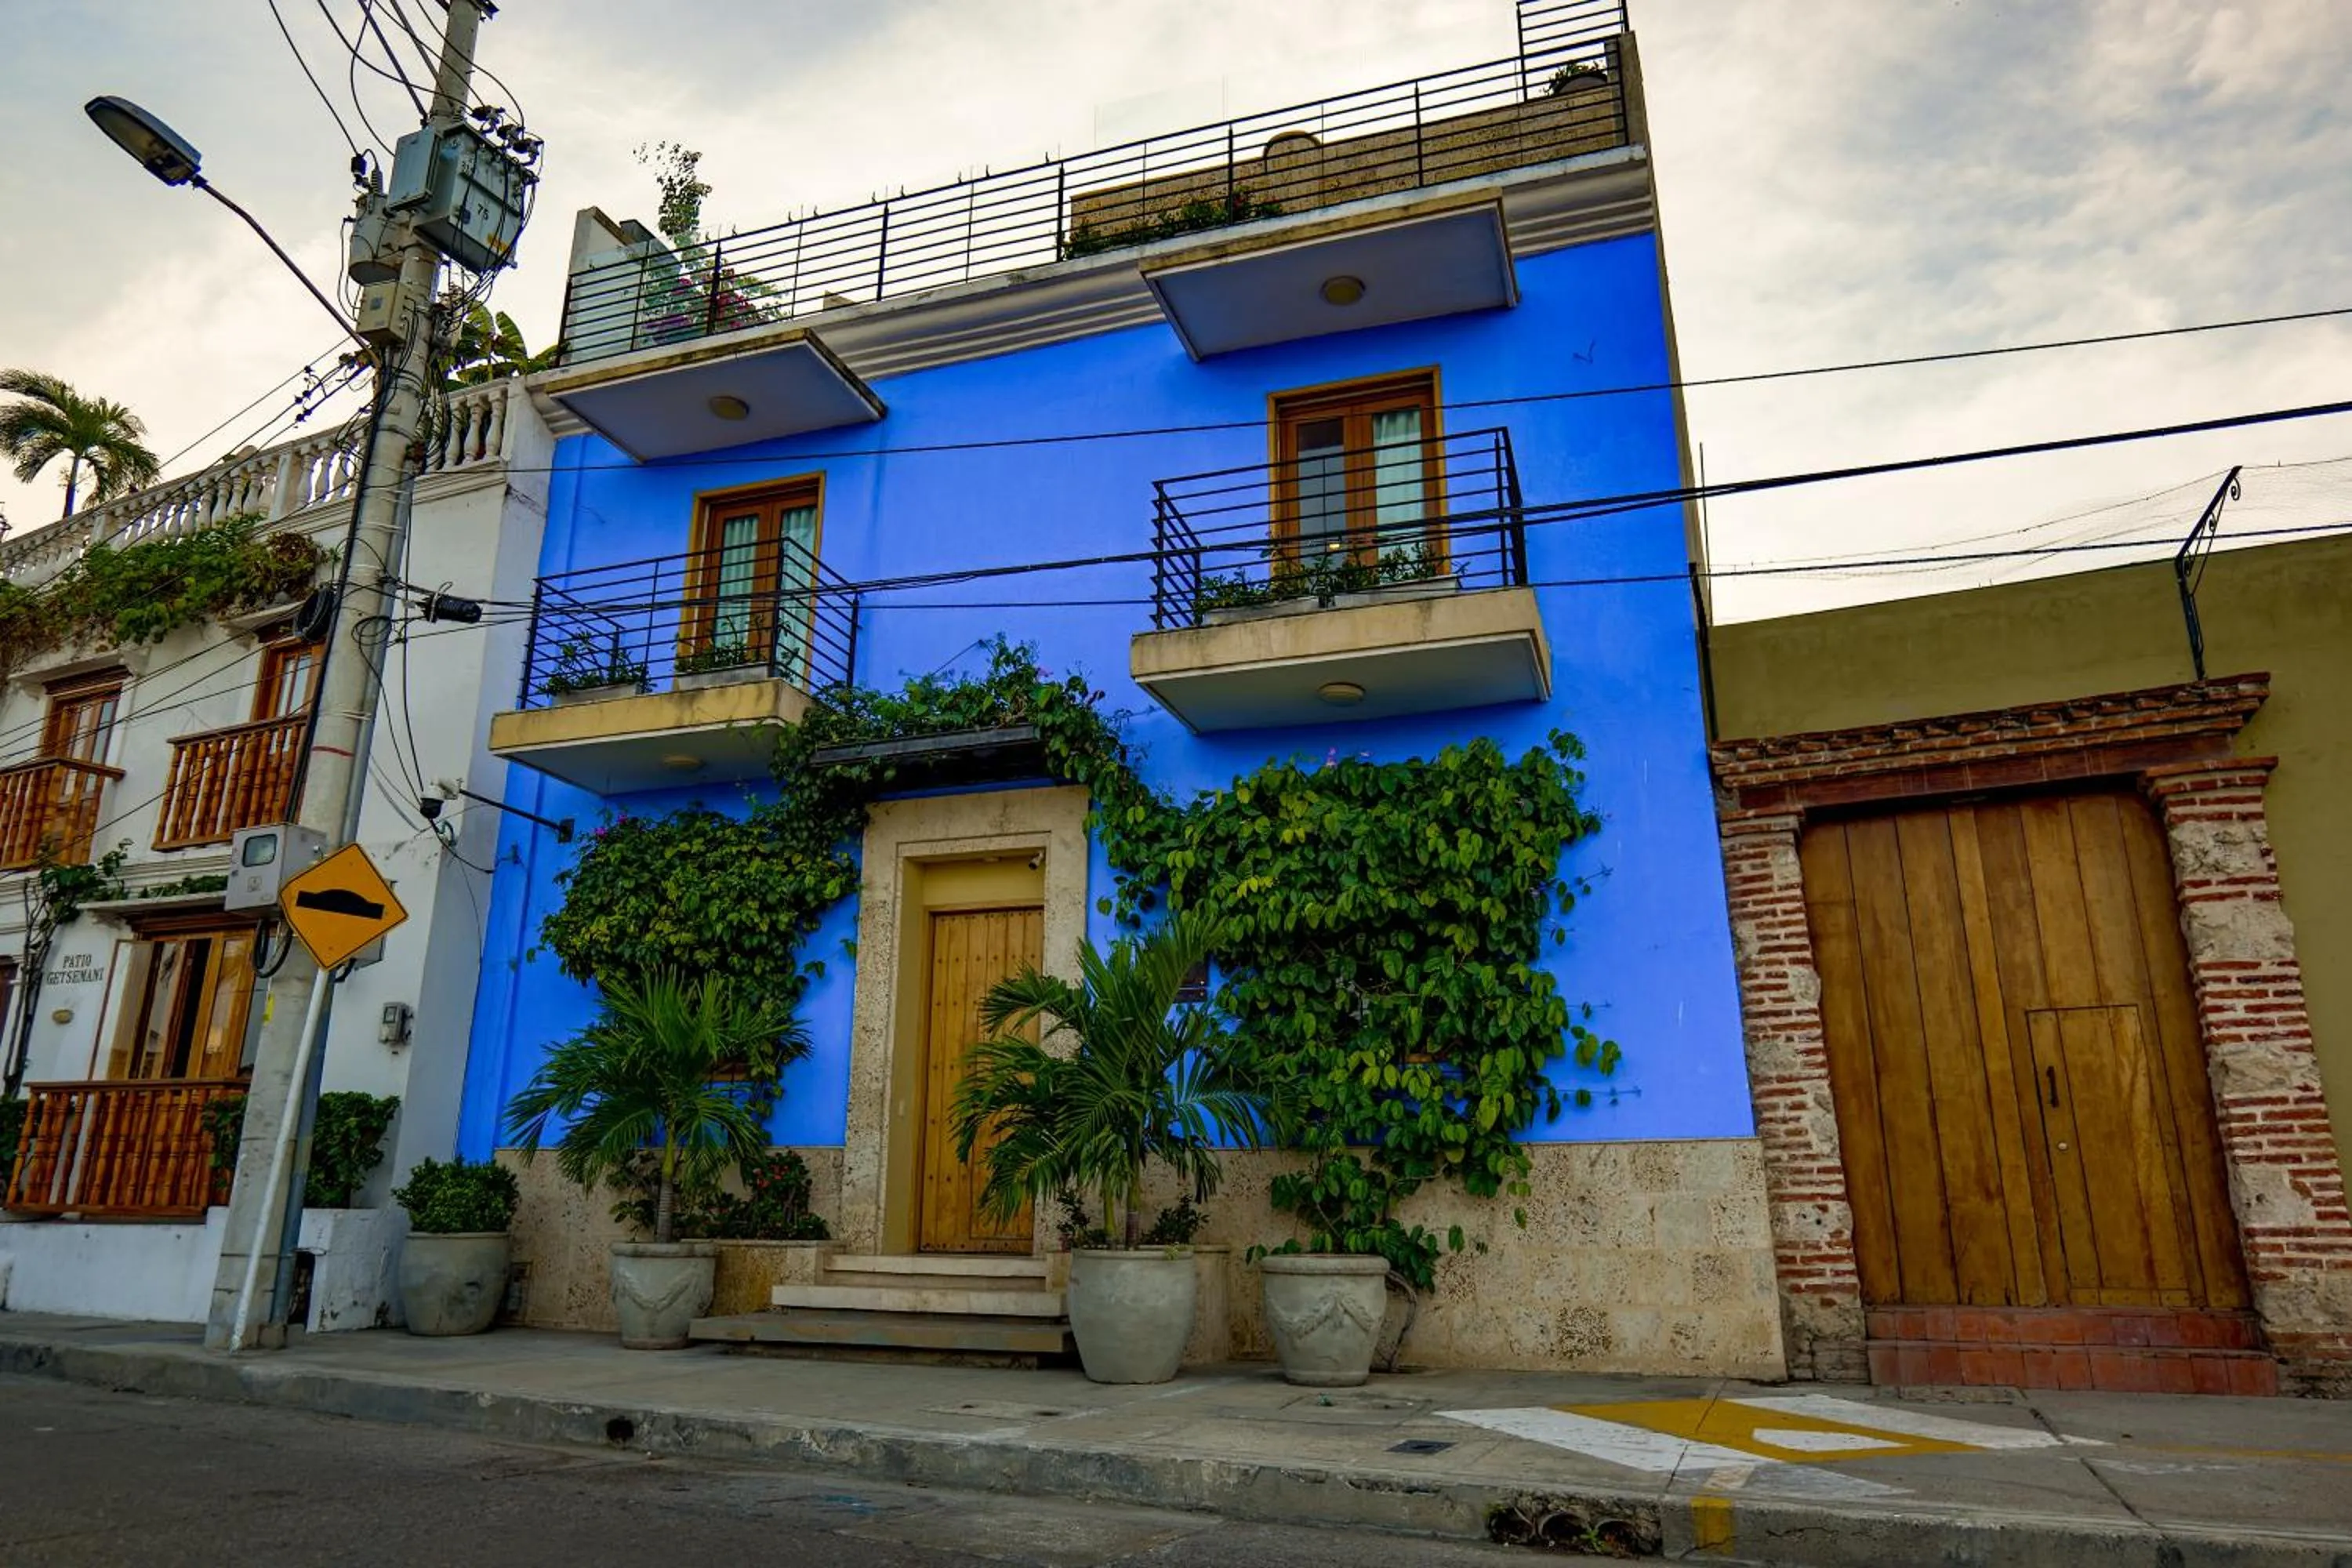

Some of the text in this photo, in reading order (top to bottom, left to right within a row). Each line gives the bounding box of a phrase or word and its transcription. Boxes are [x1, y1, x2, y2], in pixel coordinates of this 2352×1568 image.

[477, 203, 490, 220] 75
[63, 954, 92, 968] PATIO
[47, 967, 104, 985] GETSEMANI
